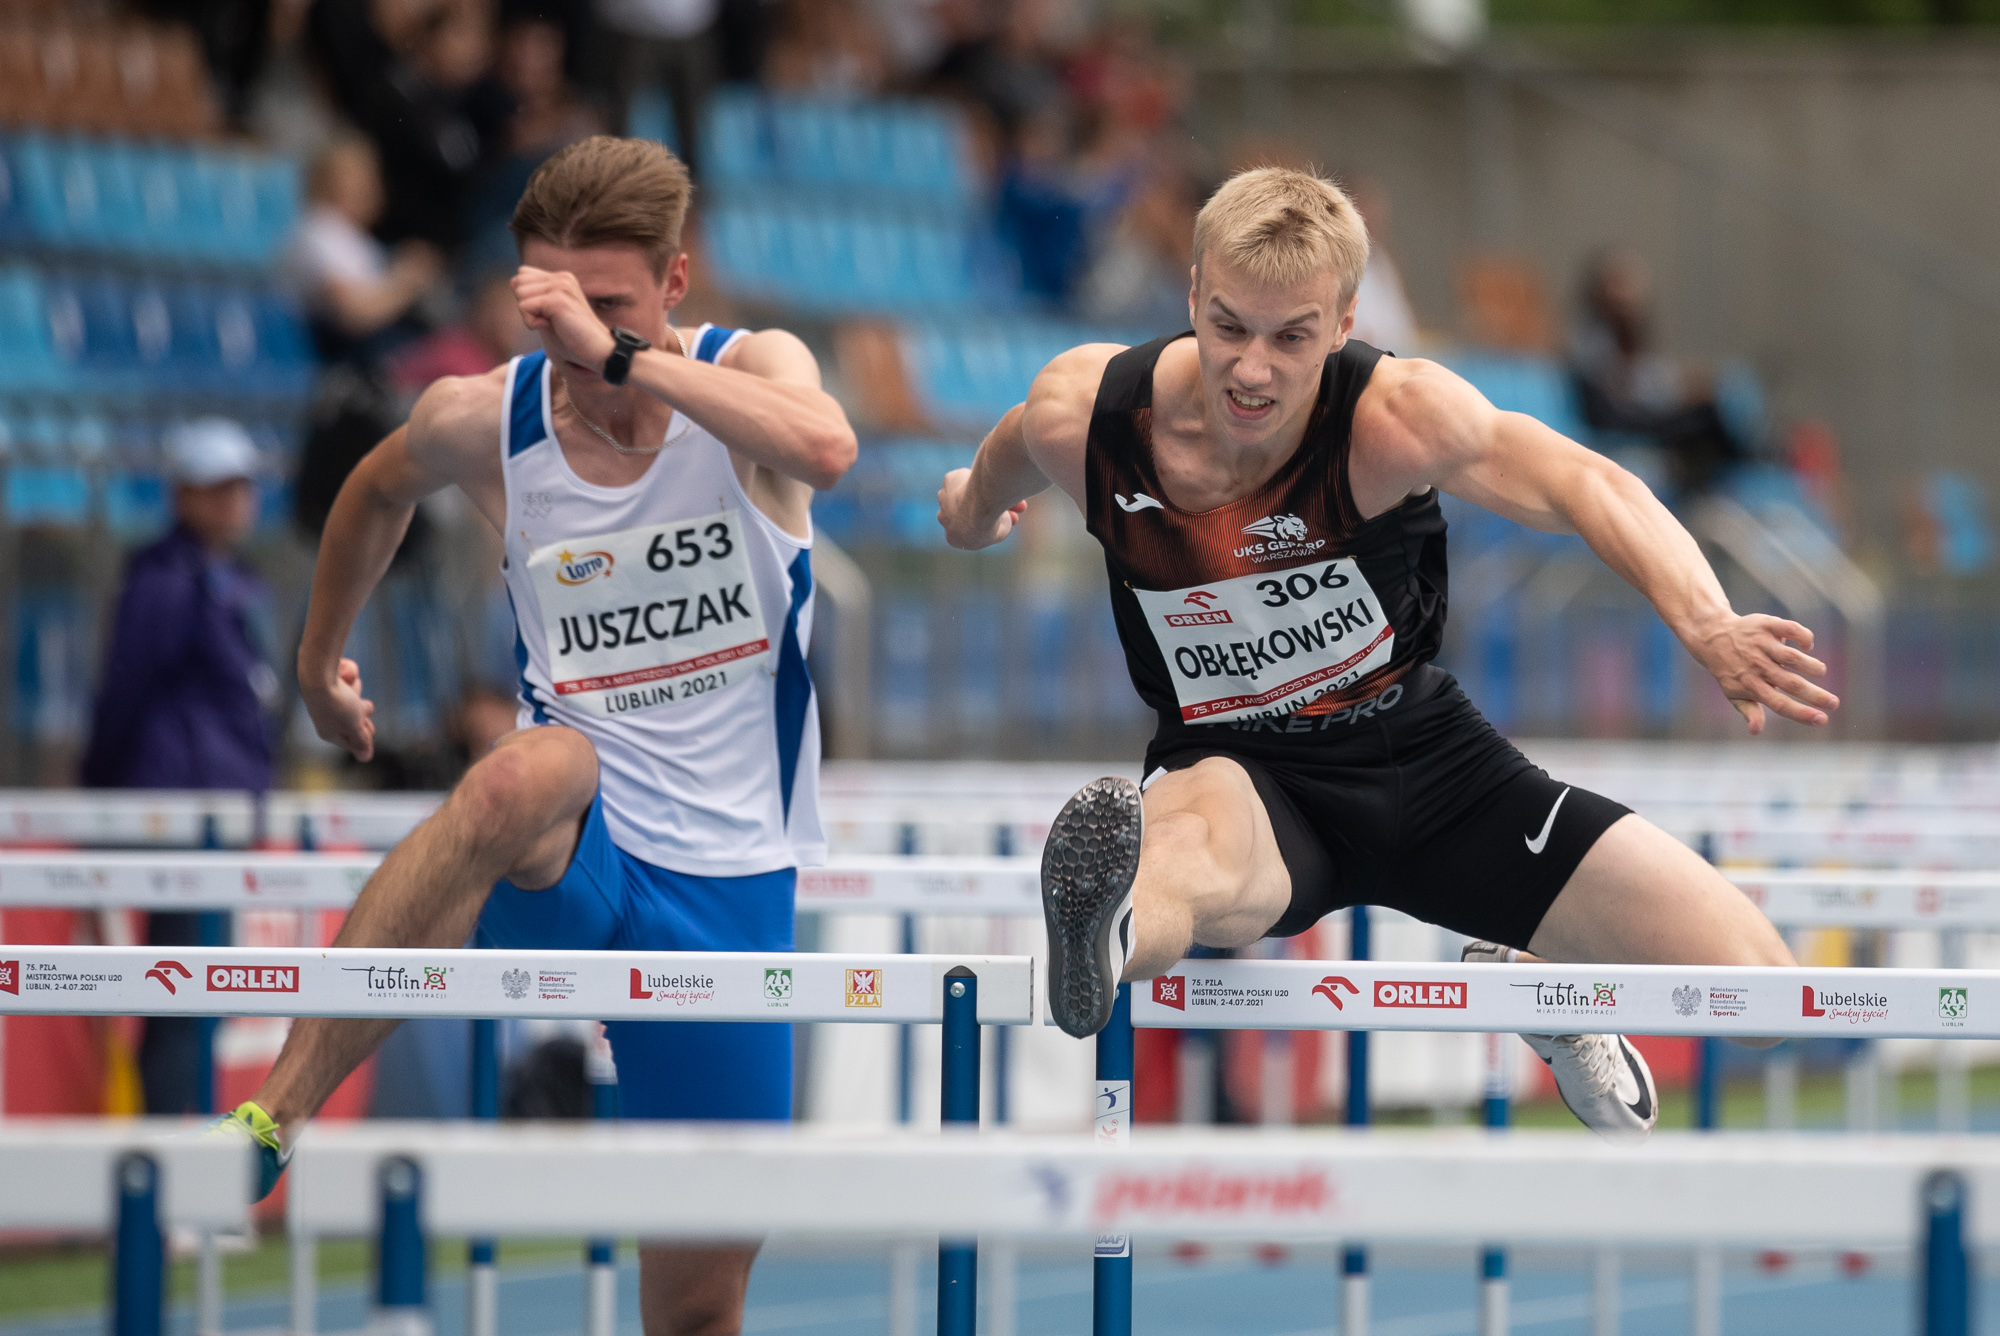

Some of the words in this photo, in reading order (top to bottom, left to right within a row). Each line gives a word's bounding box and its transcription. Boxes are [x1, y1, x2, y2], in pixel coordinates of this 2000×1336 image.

[646, 522, 733, 573] 653
[1233, 543, 1265, 558] UKS
[1267, 539, 1326, 551] GEPARD
[1251, 548, 1316, 564] WARSZAWA
[565, 557, 603, 580] LOTTO
[1256, 562, 1350, 608] 306
[559, 583, 752, 656] JUSZCZAK
[1169, 612, 1228, 626] ORLEN
[1174, 597, 1375, 681] OBŁĘKOWSKI
[1192, 706, 1210, 716] 75.
[1211, 698, 1243, 711] PZLA
[1244, 672, 1326, 705] MISTRZOSTWA
[1327, 651, 1366, 677] POLSKI
[1366, 633, 1385, 653] U20
[605, 685, 674, 713] LUBLIN
[680, 671, 728, 698] 2021
[1320, 684, 1403, 730] PRO
[26, 963, 37, 971] 75.
[39, 963, 57, 971] PZLA
[25, 973, 78, 981] MISTRZOSTWA
[80, 974, 106, 982] POLSKI
[108, 974, 123, 982] U20
[211, 968, 294, 989] ORLEN
[539, 975, 566, 983] Kultury
[1205, 979, 1223, 987] PZLA
[26, 983, 53, 991] LUBLIN,
[54, 983, 98, 991] 2-4.07.2021
[1246, 989, 1272, 997] POLSKI
[1274, 989, 1289, 997] U20
[1377, 984, 1462, 1005] ORLEN
[656, 990, 688, 1006] Smakuj
[689, 990, 715, 1005] życie!
[847, 994, 879, 1006] PZLA
[1710, 992, 1737, 1000] Kultury
[1828, 1008, 1862, 1024] Smakuj
[1862, 1008, 1889, 1023] życie!
